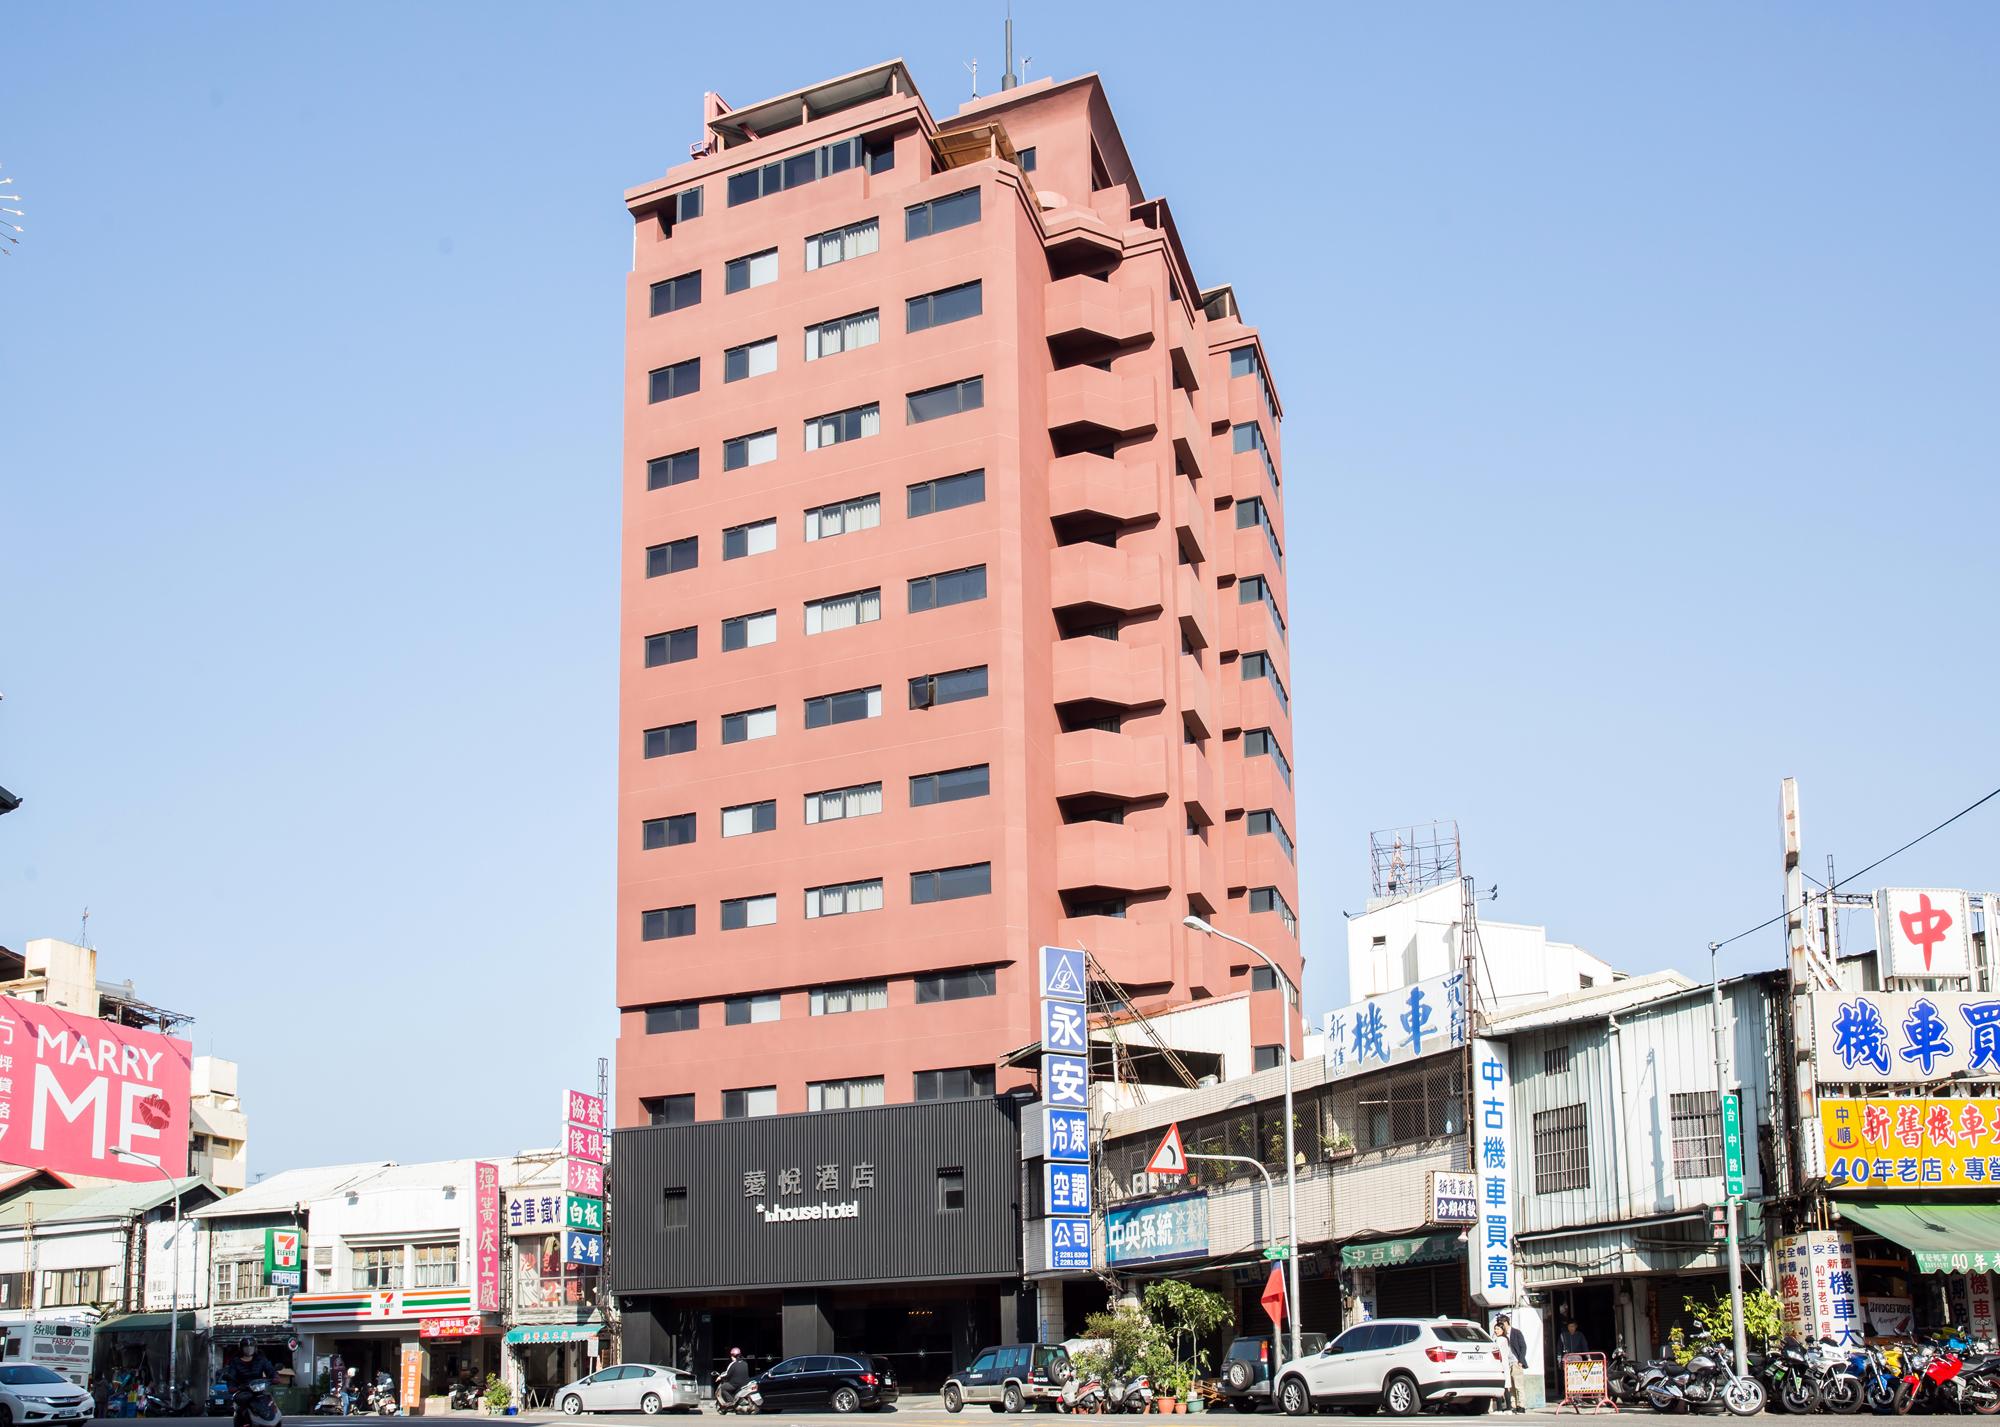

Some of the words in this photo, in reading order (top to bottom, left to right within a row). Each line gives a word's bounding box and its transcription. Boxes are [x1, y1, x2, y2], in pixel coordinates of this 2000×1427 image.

[1898, 893, 1953, 972] 中
[1351, 986, 1438, 1064] 機車
[37, 1024, 163, 1082] MARRY
[30, 1063, 163, 1168] ME
[571, 1094, 602, 1125] 協發
[1835, 1106, 1851, 1144] 中順
[570, 1128, 602, 1158] 傢俱
[1052, 1117, 1086, 1153] 冷凍
[1726, 1108, 1738, 1172] 台中路
[570, 1165, 600, 1193] 沙發
[1481, 1056, 1509, 1290] 中古機車買賣
[1831, 1157, 1942, 1182] 40年老店
[1053, 1172, 1087, 1208] 空調
[1438, 1199, 1477, 1217] 分期付款
[569, 1200, 601, 1229] 白板
[822, 1200, 859, 1219] hotel
[479, 1167, 497, 1308] 彈簧床工廠
[570, 1235, 600, 1263] 金庫
[1054, 1222, 1088, 1248] 公司
[1109, 1211, 1173, 1253] 中央系統
[1812, 1244, 1852, 1255] 安全帽
